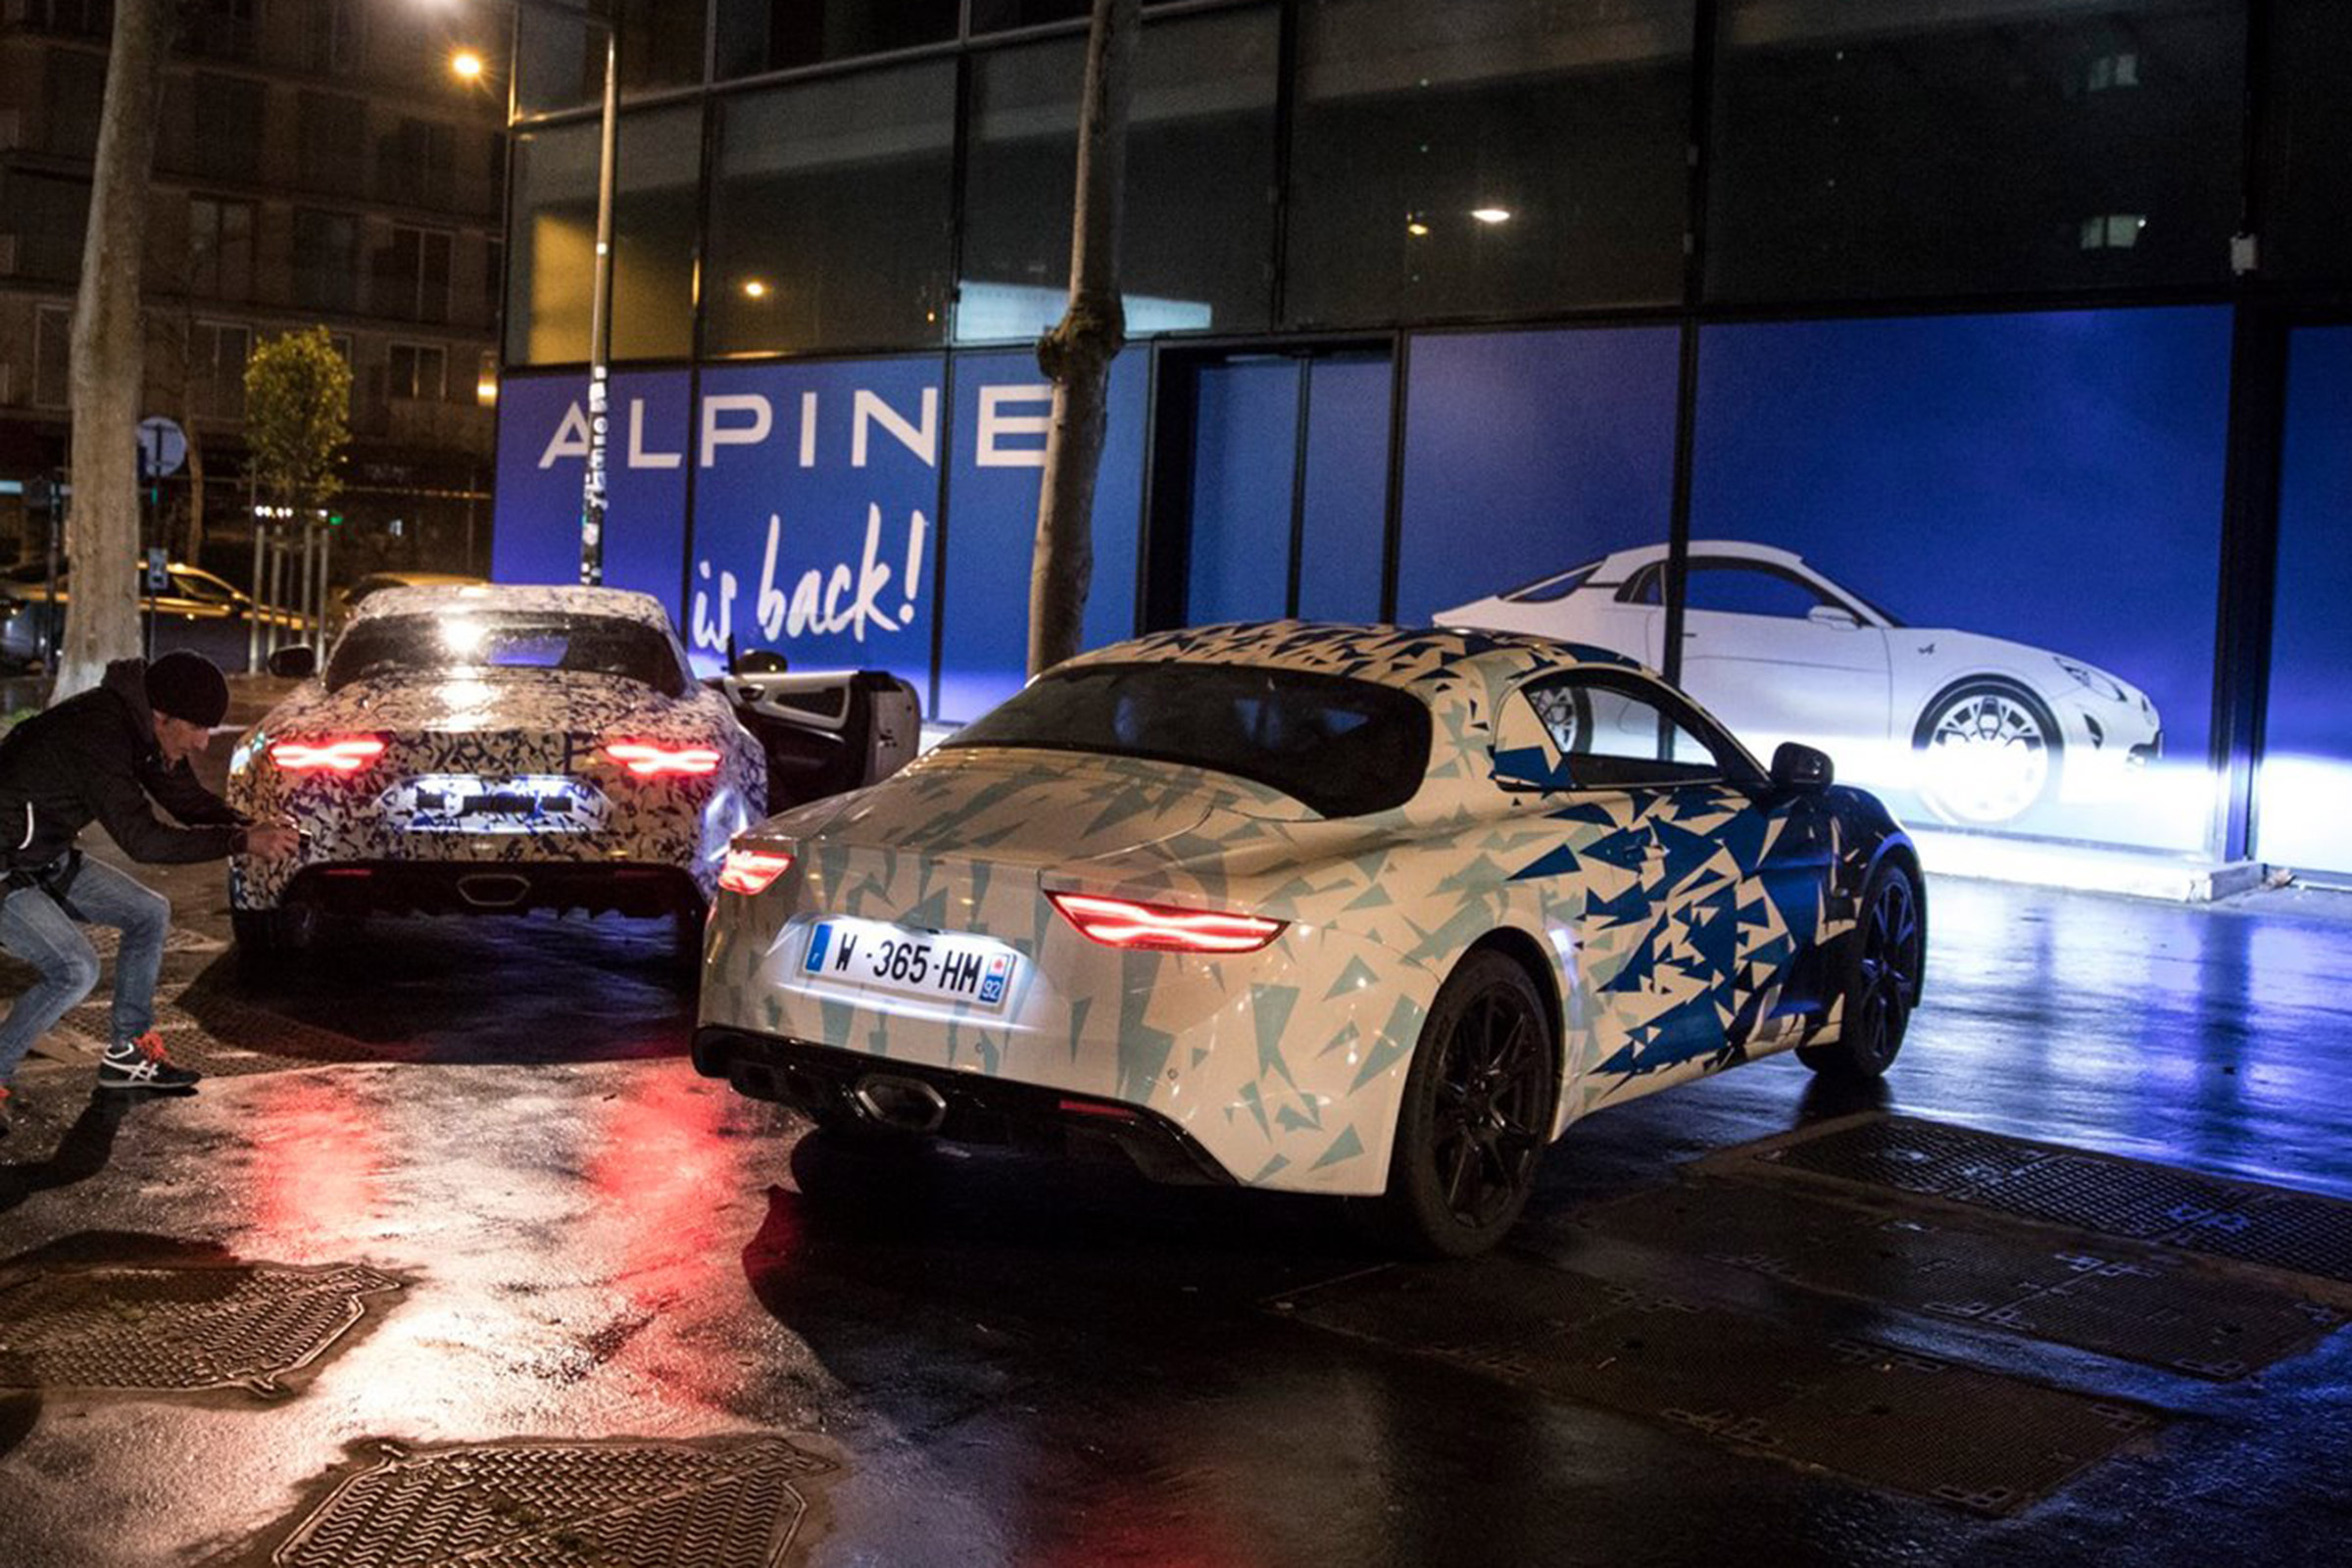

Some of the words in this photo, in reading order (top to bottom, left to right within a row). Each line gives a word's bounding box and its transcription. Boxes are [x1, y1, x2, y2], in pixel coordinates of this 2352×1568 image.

[538, 383, 1054, 469] ALPINE
[692, 559, 737, 655] is
[757, 501, 926, 643] back!
[982, 979, 1001, 1000] 92
